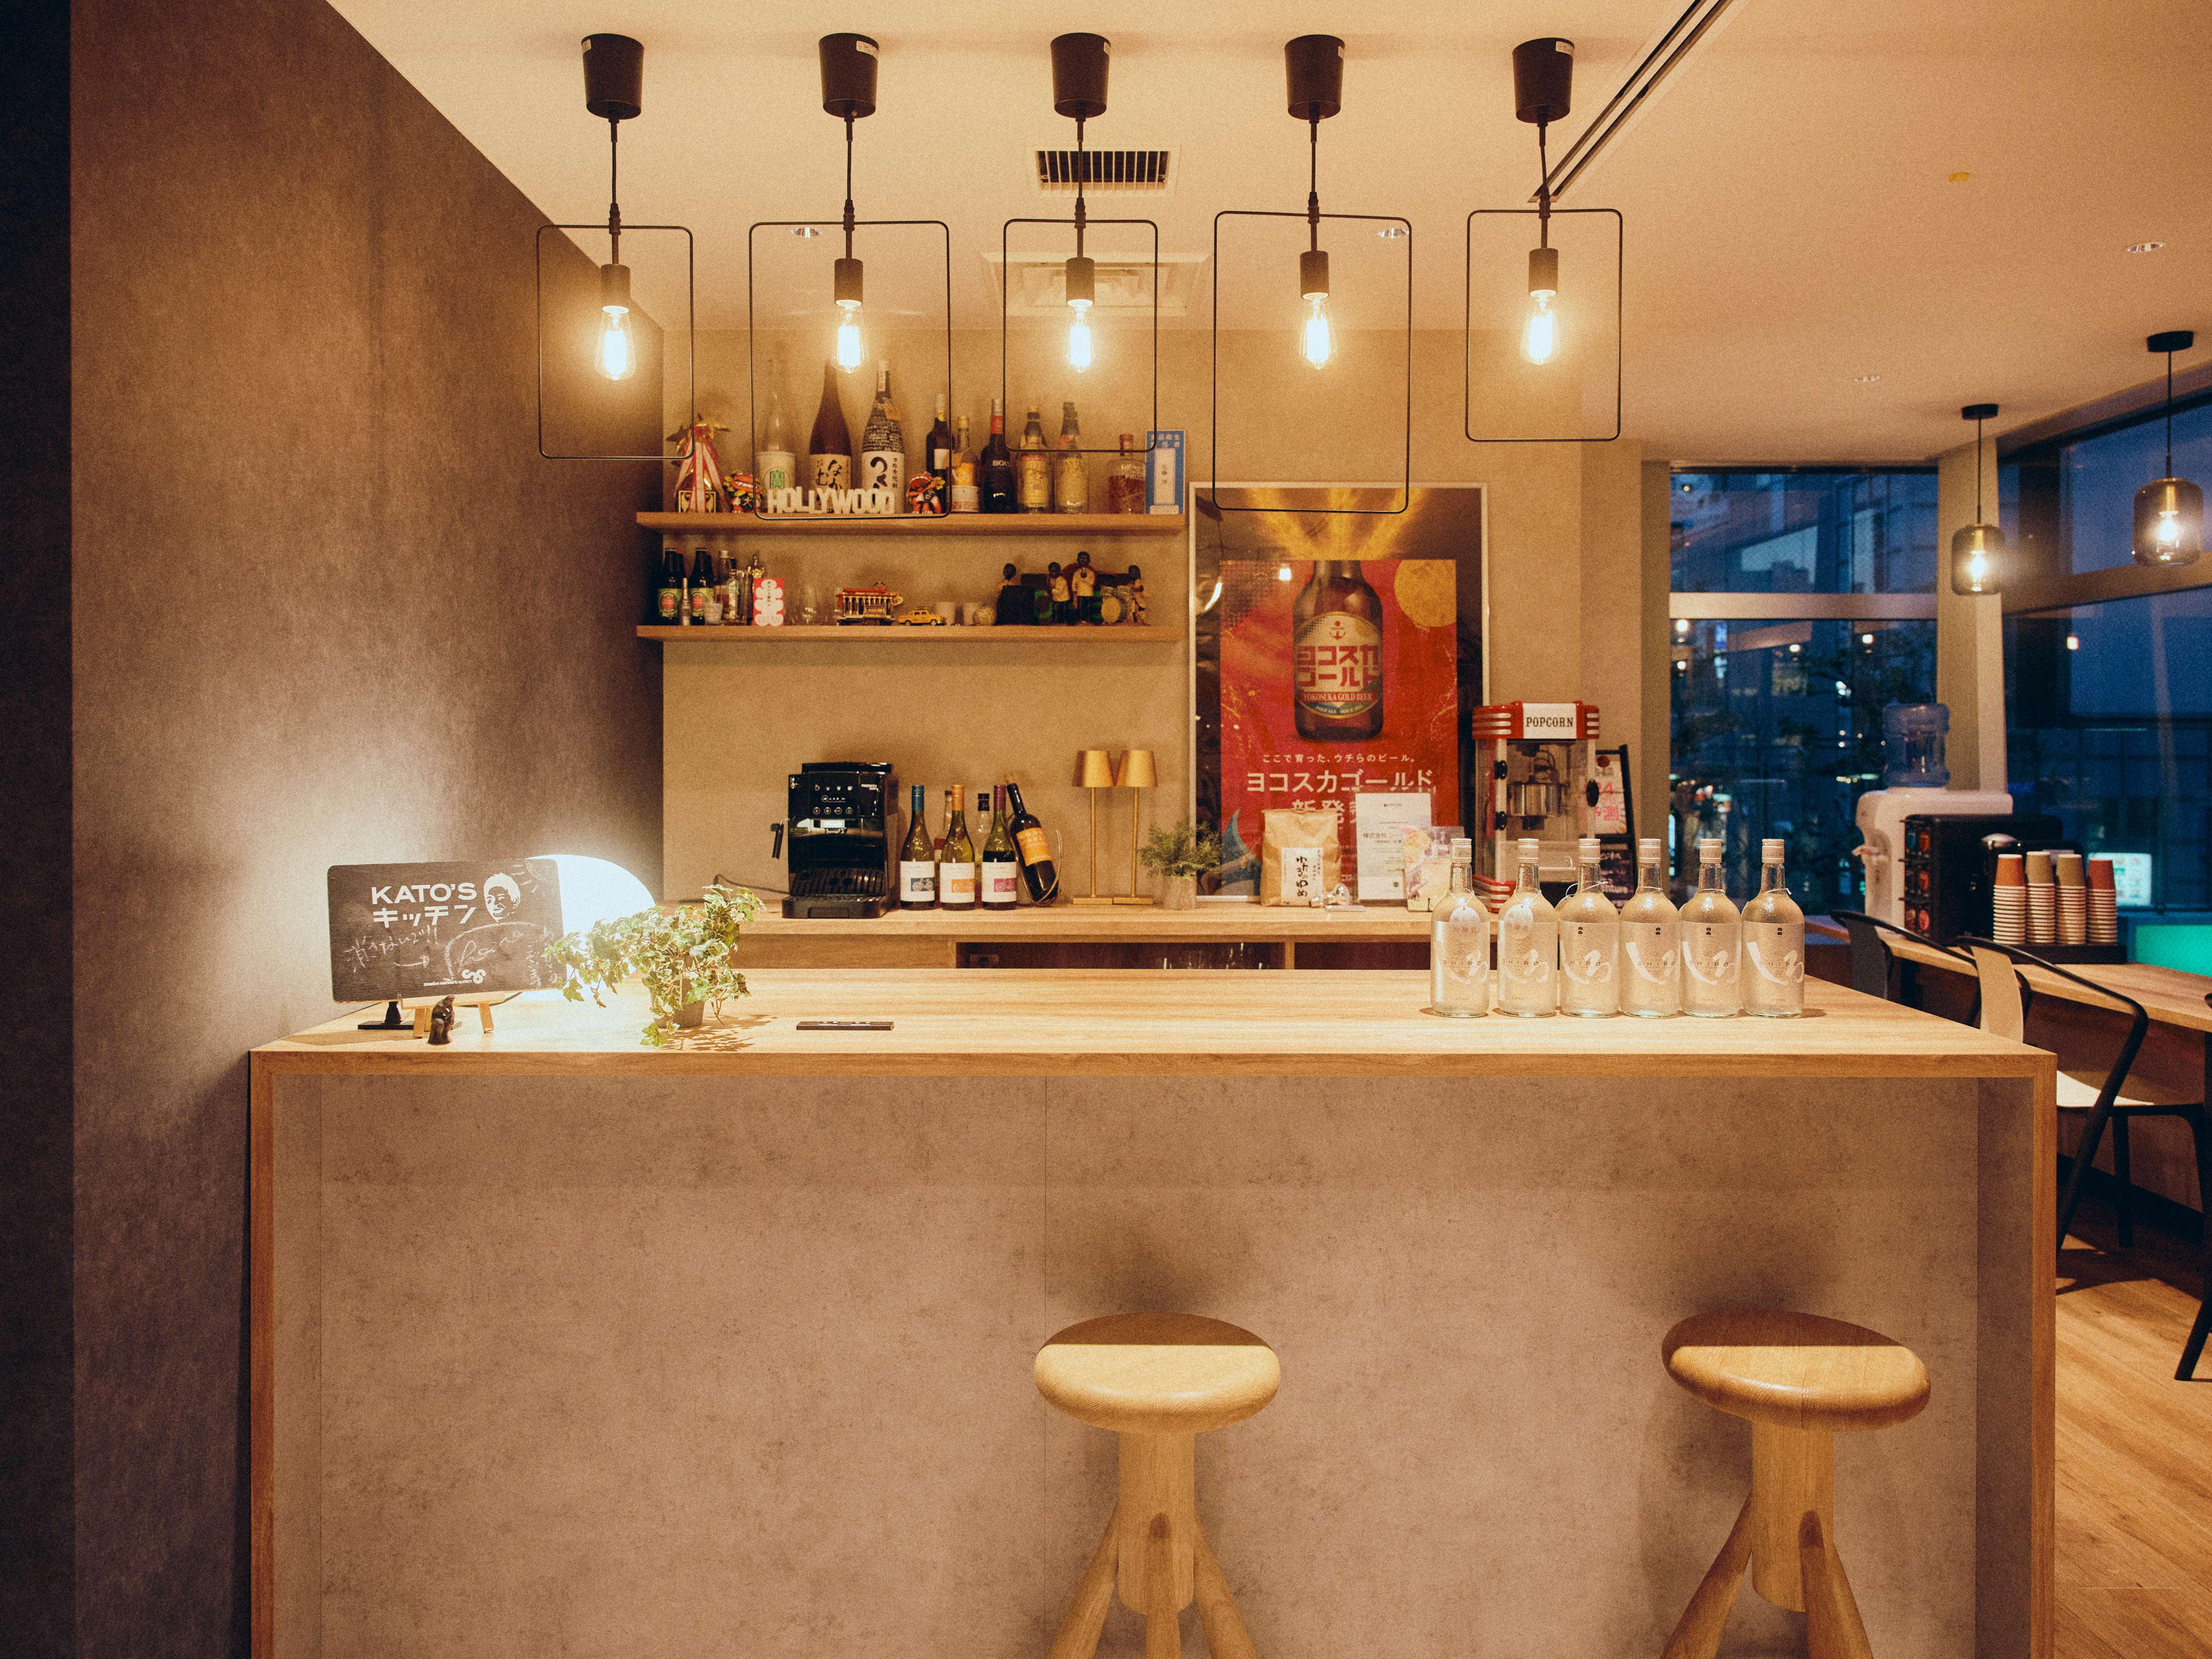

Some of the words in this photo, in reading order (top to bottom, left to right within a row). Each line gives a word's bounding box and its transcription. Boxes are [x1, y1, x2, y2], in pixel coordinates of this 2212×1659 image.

[768, 486, 895, 514] HOLLYWOOD
[1298, 645, 1379, 666] ヨコスカ
[1526, 717, 1573, 727] POPCORN
[1263, 754, 1415, 763] ここで育った、ウチらのビール。
[1247, 769, 1433, 793] ヨコスカゴールド
[371, 883, 477, 904] KATO'S
[373, 905, 476, 928] キッチン
